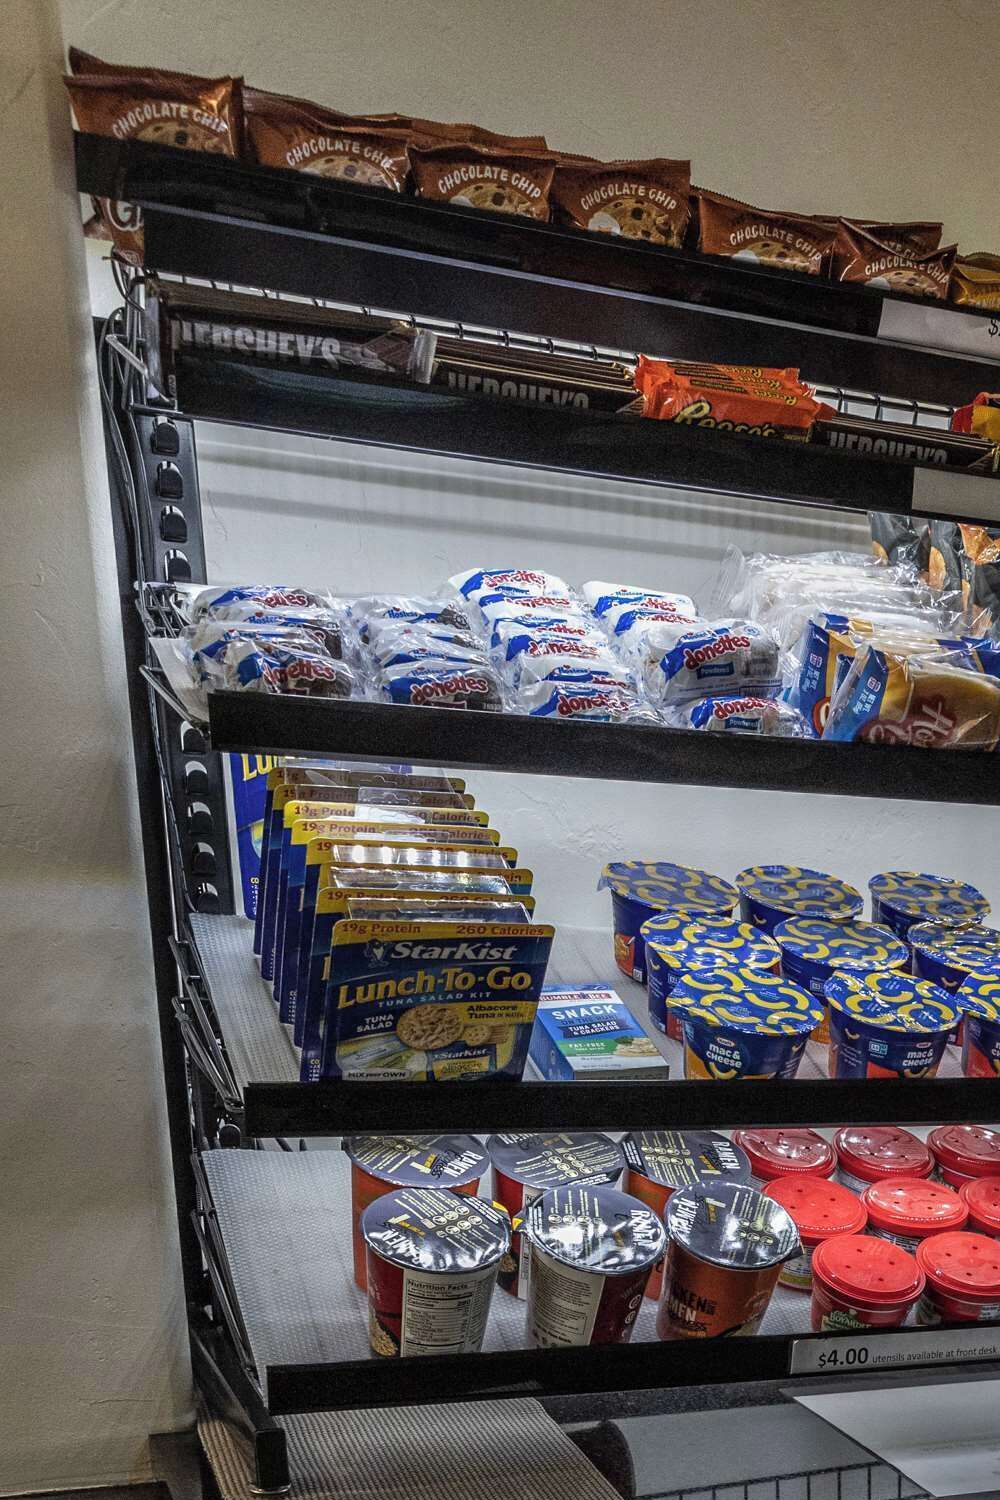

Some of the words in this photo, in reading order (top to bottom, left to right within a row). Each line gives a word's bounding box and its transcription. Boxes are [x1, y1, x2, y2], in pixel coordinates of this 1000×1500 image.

[112, 102, 189, 140] CHOCOLATE
[192, 108, 229, 134] CHIP
[285, 136, 361, 167] CHOCOLATE
[437, 165, 509, 195] CHOCOLATE
[510, 172, 542, 199] CHIP
[580, 182, 646, 211] CHOCOLATE
[648, 187, 677, 211] CHIP
[729, 224, 793, 246] CHOCOLATE
[795, 238, 822, 262] CHIP
[864, 255, 926, 276] CHOCOLATE
[926, 262, 949, 284] CHIP
[683, 634, 751, 671] donettes
[410, 674, 489, 706] donettes
[341, 923, 367, 935] 19g
[371, 923, 421, 934] Protein
[456, 924, 486, 935] 260
[490, 925, 545, 936] Calories
[391, 940, 518, 961] StarKist
[336, 966, 534, 1010] Lunch-To-Go
[378, 997, 414, 1009] TUNA
[420, 992, 463, 1002] SALAD
[469, 991, 492, 999] KIT
[467, 1003, 518, 1012] Albacore
[365, 1013, 394, 1024] TUNA
[468, 1011, 496, 1020] Tuna
[551, 1003, 617, 1021] SNACK
[356, 1021, 393, 1034] SALAD
[568, 1024, 589, 1032] TUNA
[591, 1020, 617, 1029] SALAD
[580, 1025, 620, 1036] CRACKERS
[709, 1043, 731, 1057] mac
[732, 1049, 741, 1060] &
[906, 1050, 925, 1059] mac
[926, 1049, 933, 1058] &
[443, 1150, 484, 1178] RAMEN
[711, 1140, 741, 1170] RAMEN
[817, 1347, 869, 1369] $4.00
[872, 1353, 905, 1364] utensils
[906, 1350, 944, 1361] available
[945, 1350, 955, 1359] at
[955, 1347, 978, 1358] front
[978, 1345, 998, 1356] desk
